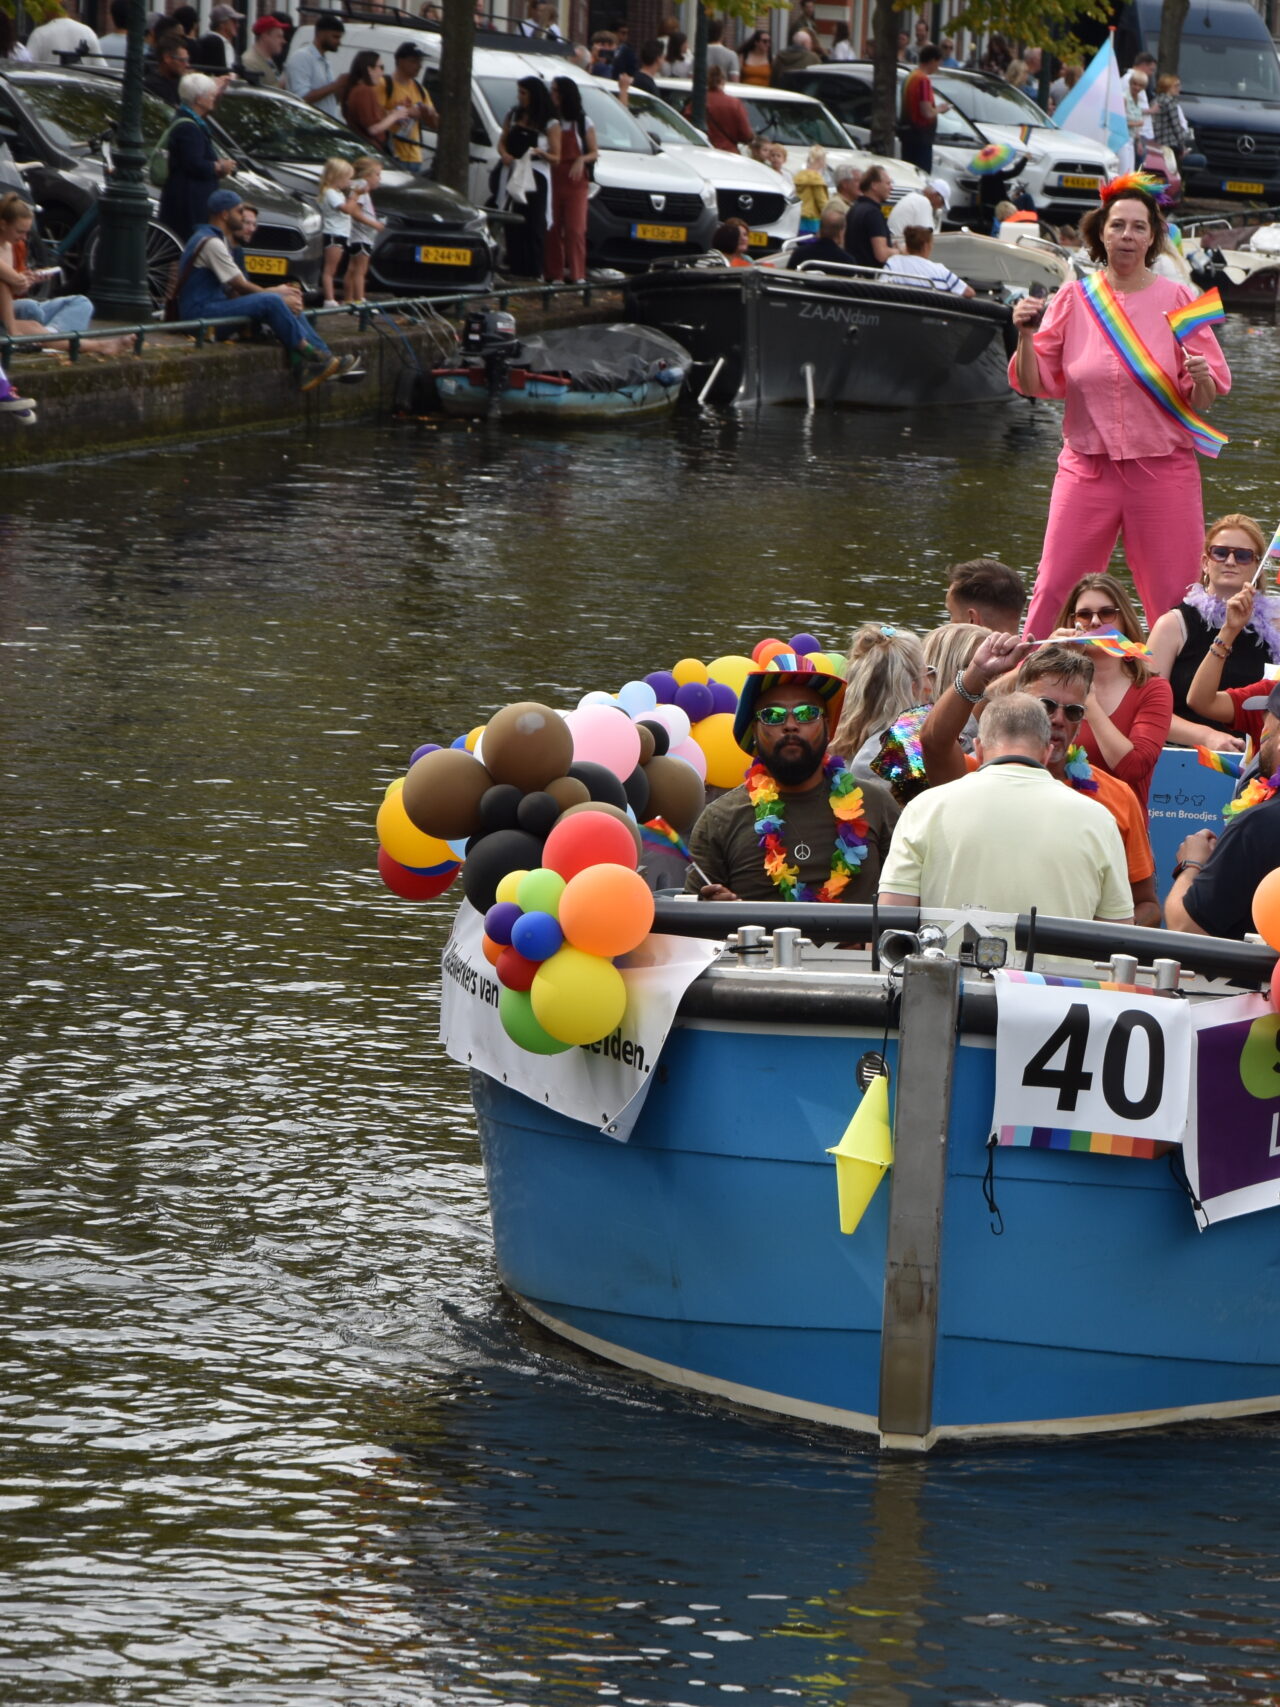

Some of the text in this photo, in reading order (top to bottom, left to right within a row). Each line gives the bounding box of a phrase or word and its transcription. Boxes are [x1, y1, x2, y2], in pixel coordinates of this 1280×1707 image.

[245, 257, 284, 273] -095-T
[799, 301, 880, 326] ZAANdam
[1148, 808, 1217, 822] tjes en Broodjes
[480, 975, 500, 1009] van
[579, 1027, 650, 1074] eiden.
[1022, 1003, 1166, 1121] 40
